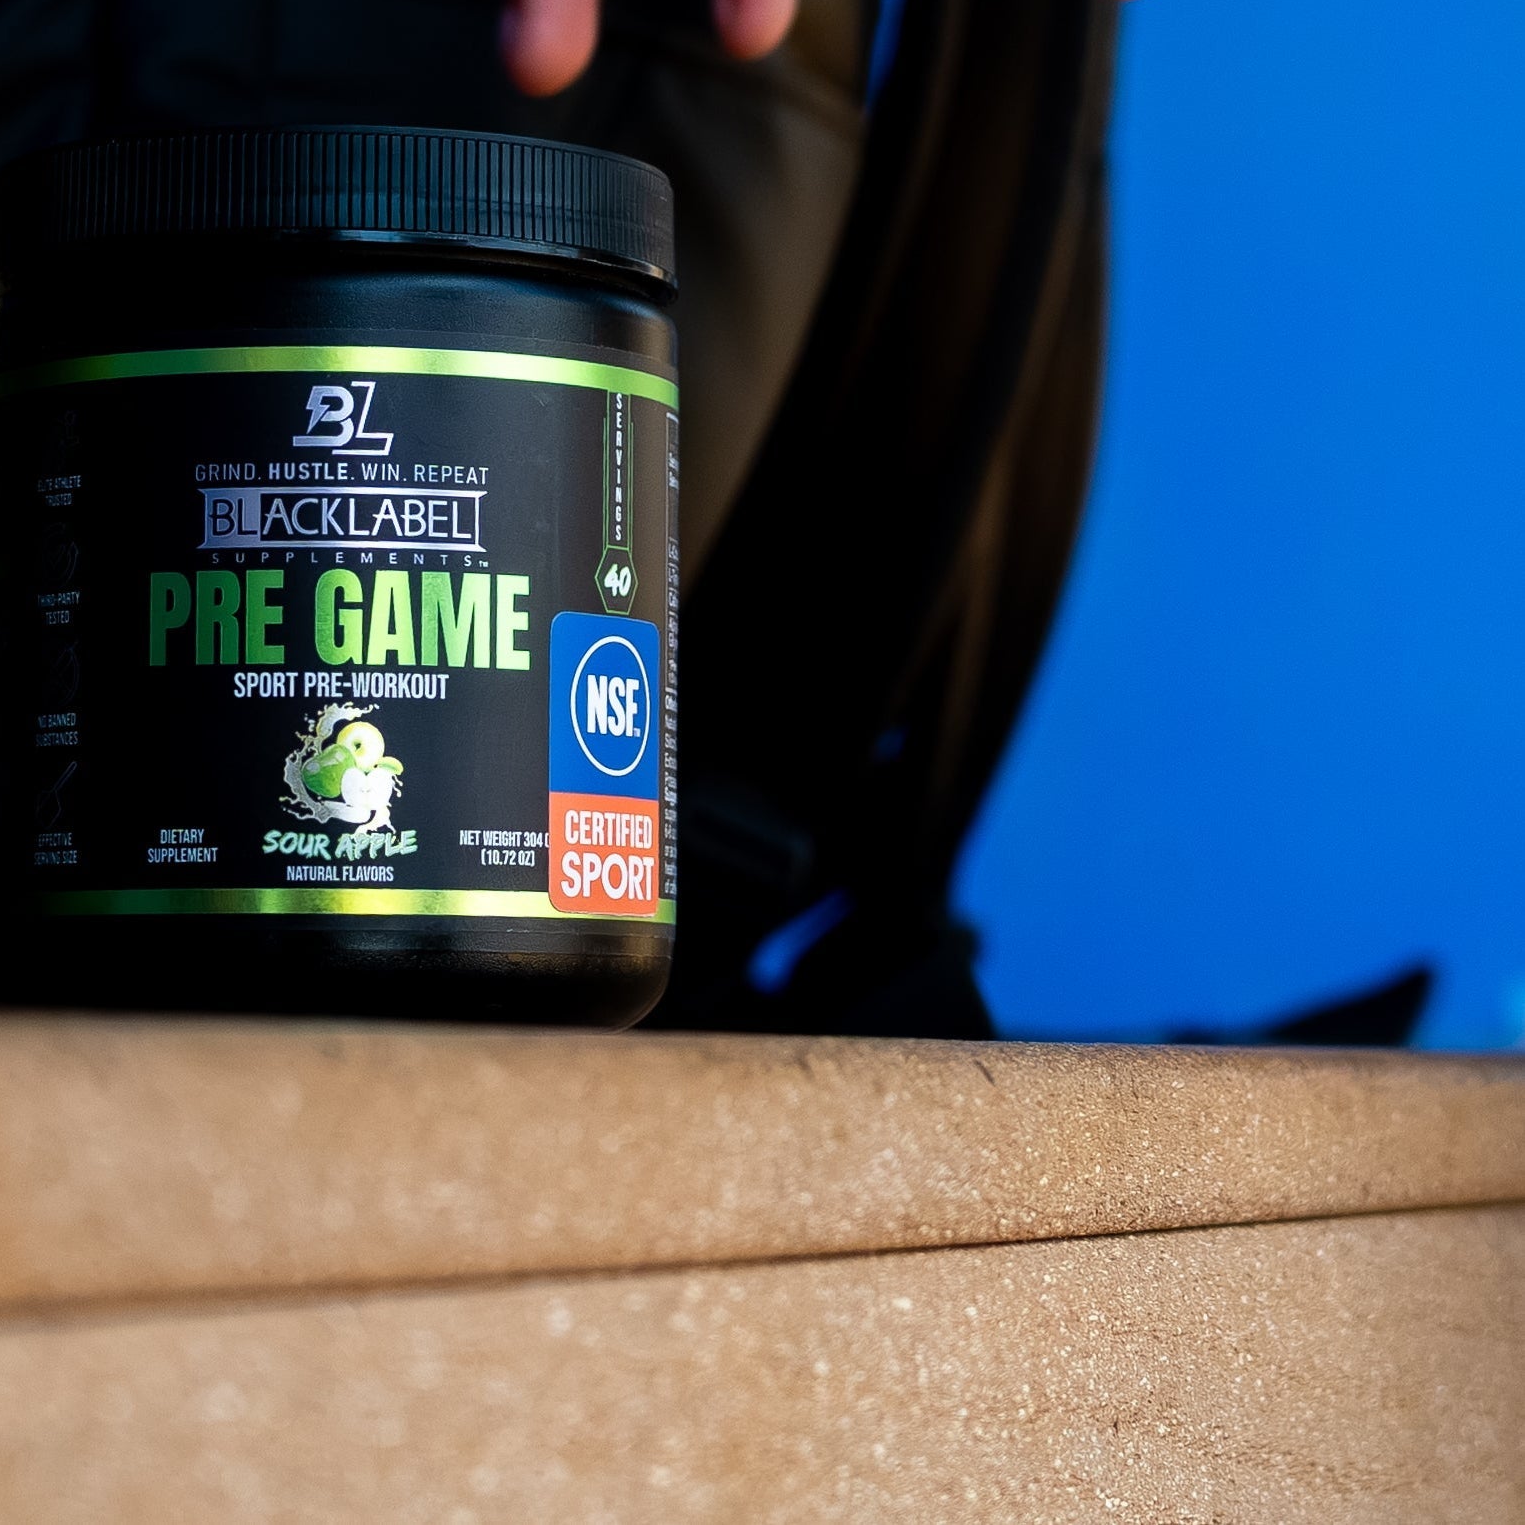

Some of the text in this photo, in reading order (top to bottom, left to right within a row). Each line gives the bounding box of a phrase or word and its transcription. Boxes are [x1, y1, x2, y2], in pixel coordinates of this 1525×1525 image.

[194, 462, 489, 486] GRIND. HUSTLE. WIN. REPEAT
[614, 392, 623, 542] SERVINGS
[208, 497, 473, 540] BLACKLABEL
[603, 563, 632, 597] 40
[45, 610, 70, 625] TESTED
[149, 568, 531, 671] PRE GAME
[233, 672, 450, 700] SPORT PRE-WORKOUT
[159, 828, 205, 845] DIETARY
[459, 830, 480, 847] NET
[482, 831, 521, 848] WEIGHT
[523, 831, 544, 848] 304
[564, 809, 654, 850] CERTIFIED
[147, 847, 219, 863] SUPPLEMENT
[261, 829, 419, 862] SOUR APPLE
[286, 865, 395, 883] NATURAL FLAVORS
[560, 850, 655, 902] SPORT
